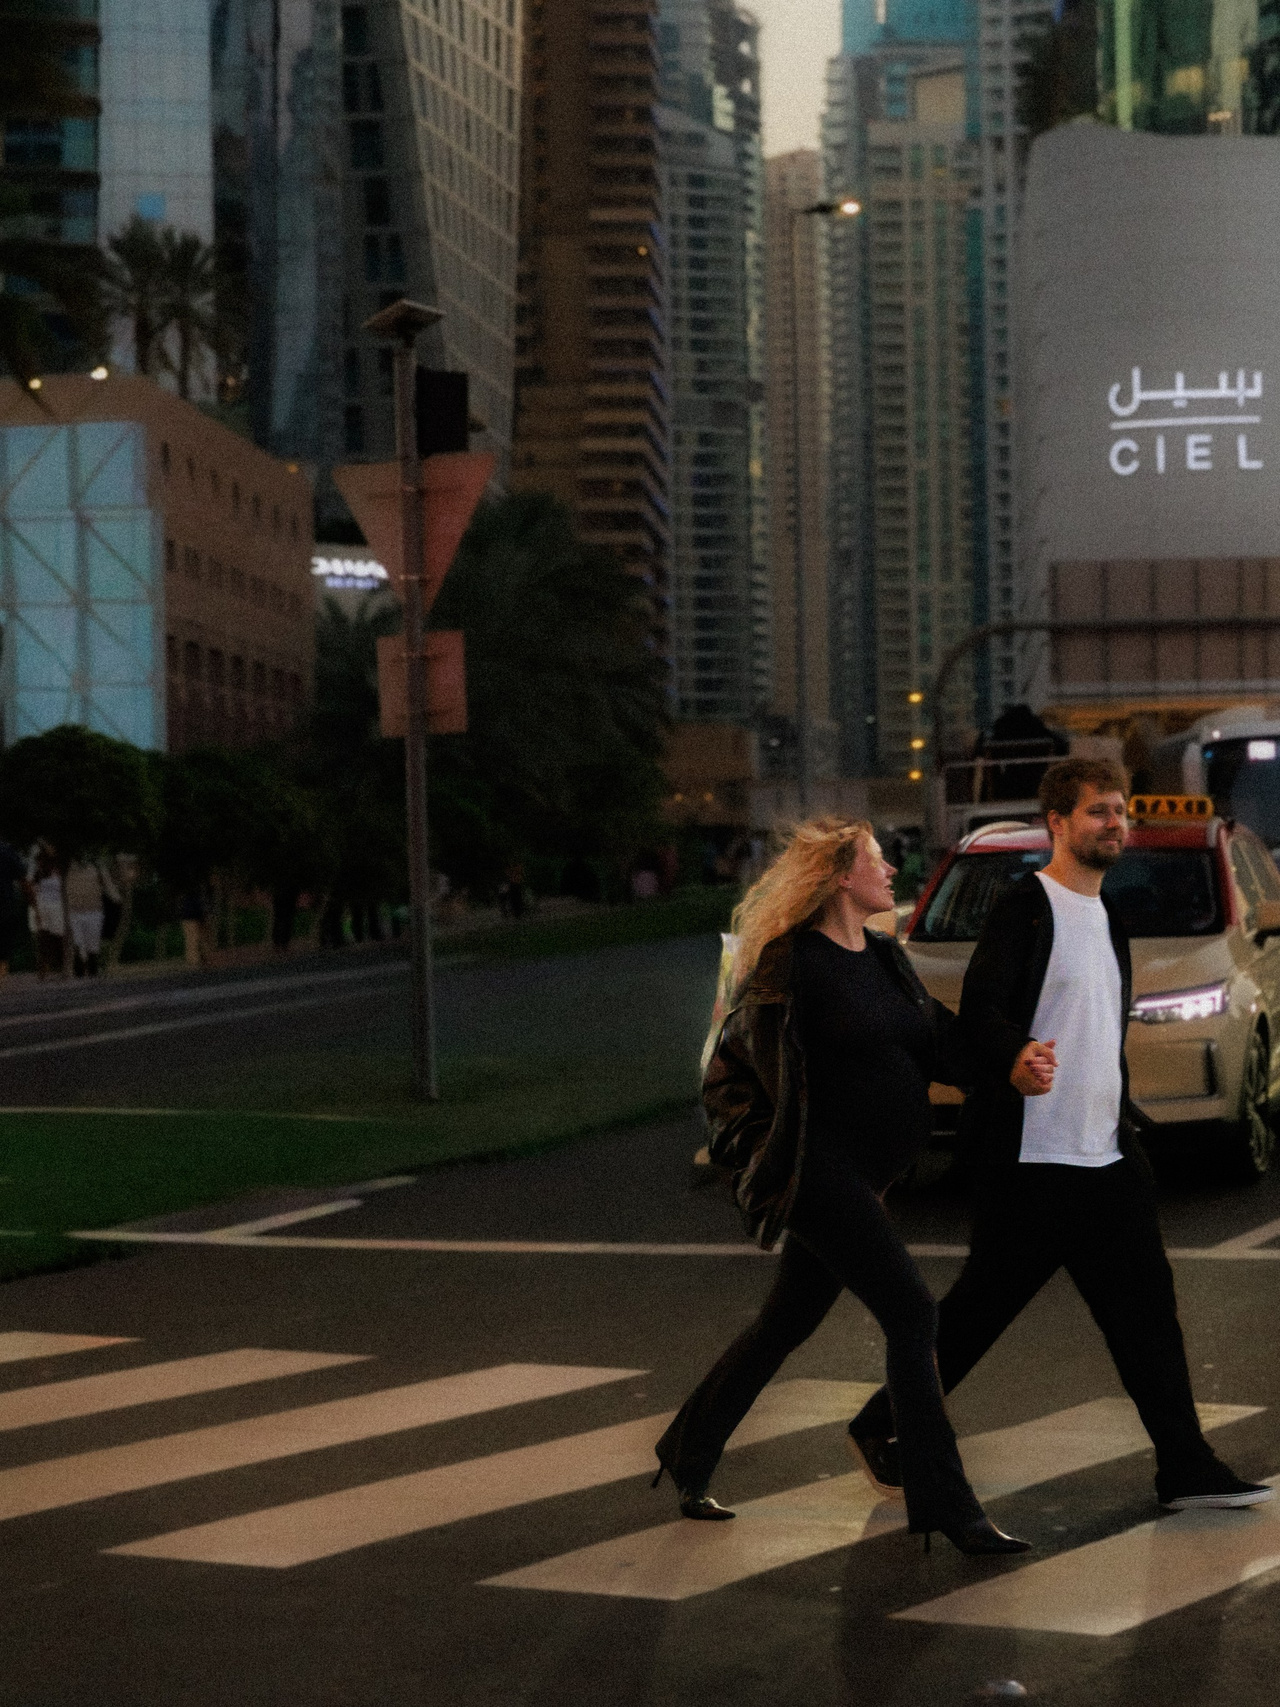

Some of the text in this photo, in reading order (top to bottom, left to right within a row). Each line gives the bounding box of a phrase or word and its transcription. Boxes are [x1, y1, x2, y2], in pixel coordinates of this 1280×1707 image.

[1108, 365, 1263, 418] سيل
[1109, 432, 1264, 476] CIEL
[1136, 797, 1203, 817] TAXI
